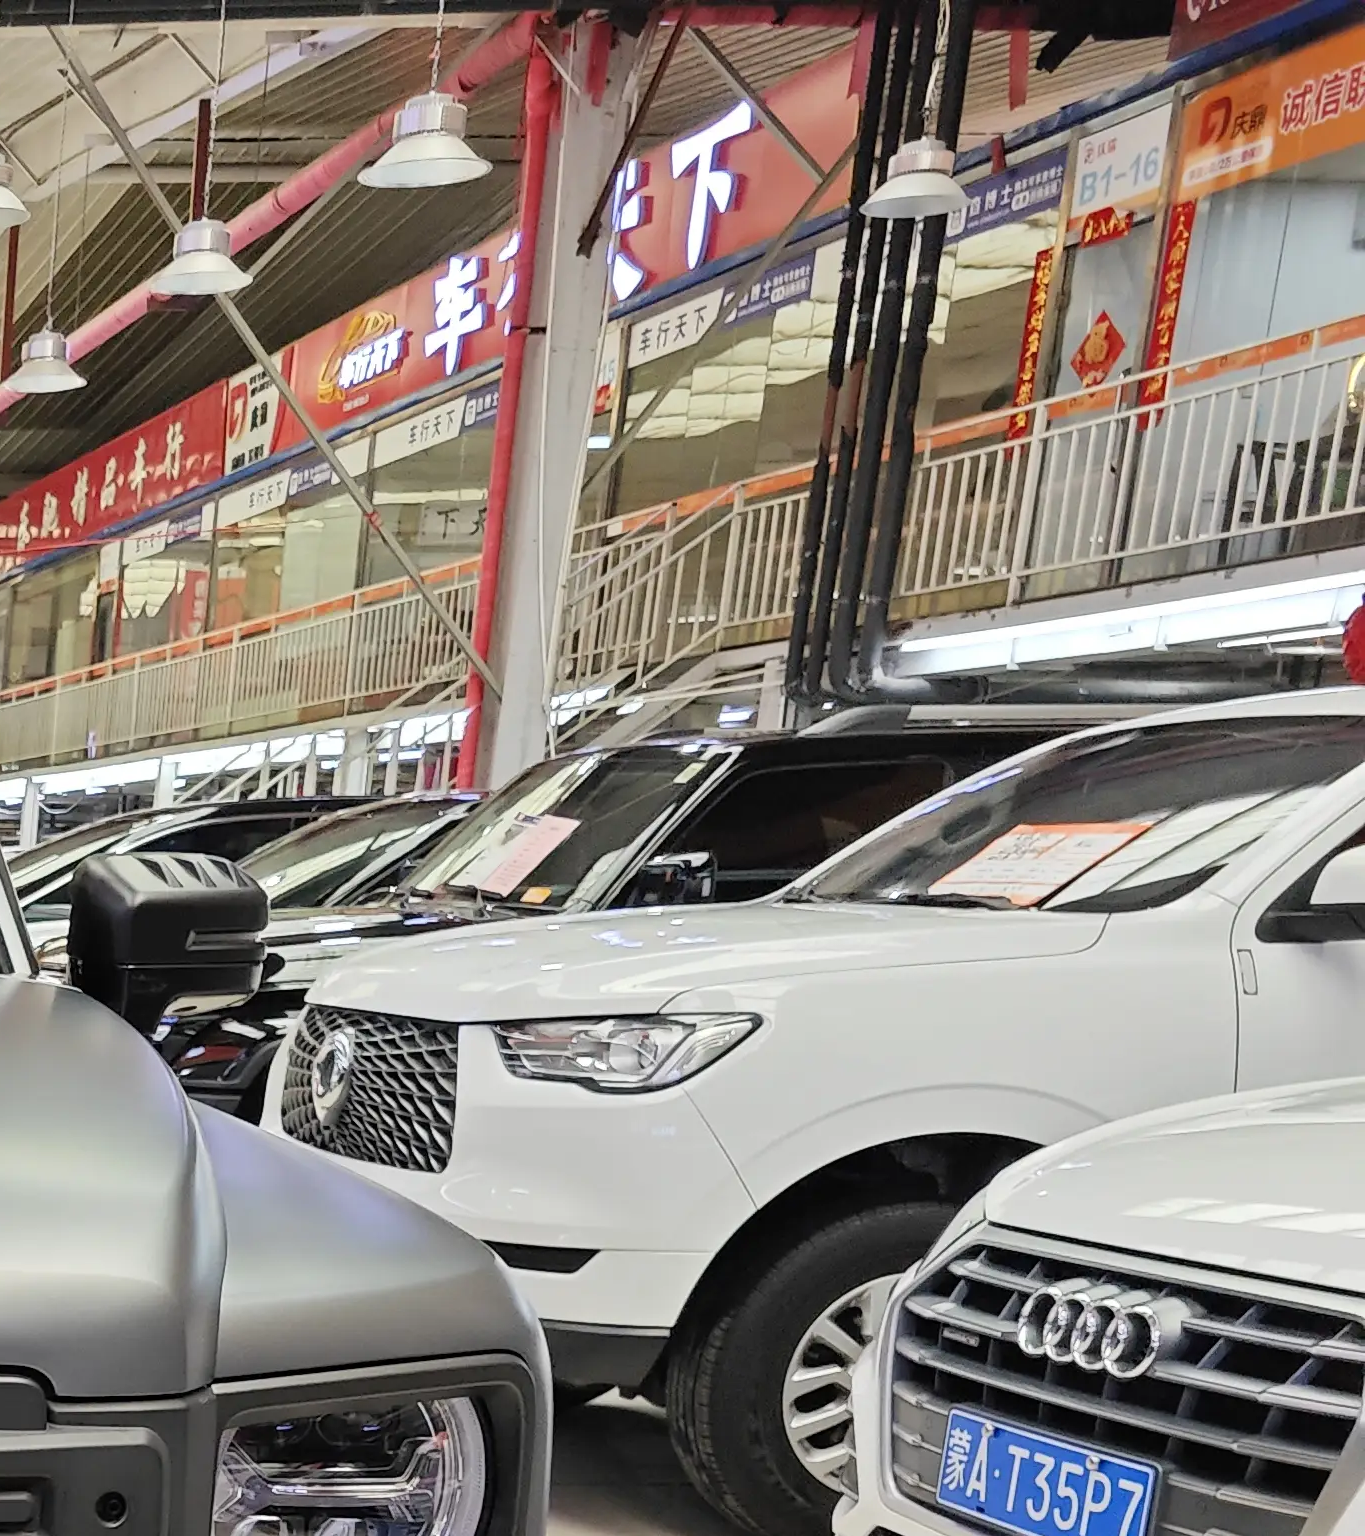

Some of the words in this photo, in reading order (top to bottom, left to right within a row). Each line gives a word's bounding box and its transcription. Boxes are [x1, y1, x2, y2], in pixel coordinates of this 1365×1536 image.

[1078, 146, 1161, 207] B1-16
[638, 304, 709, 356] 车行天下
